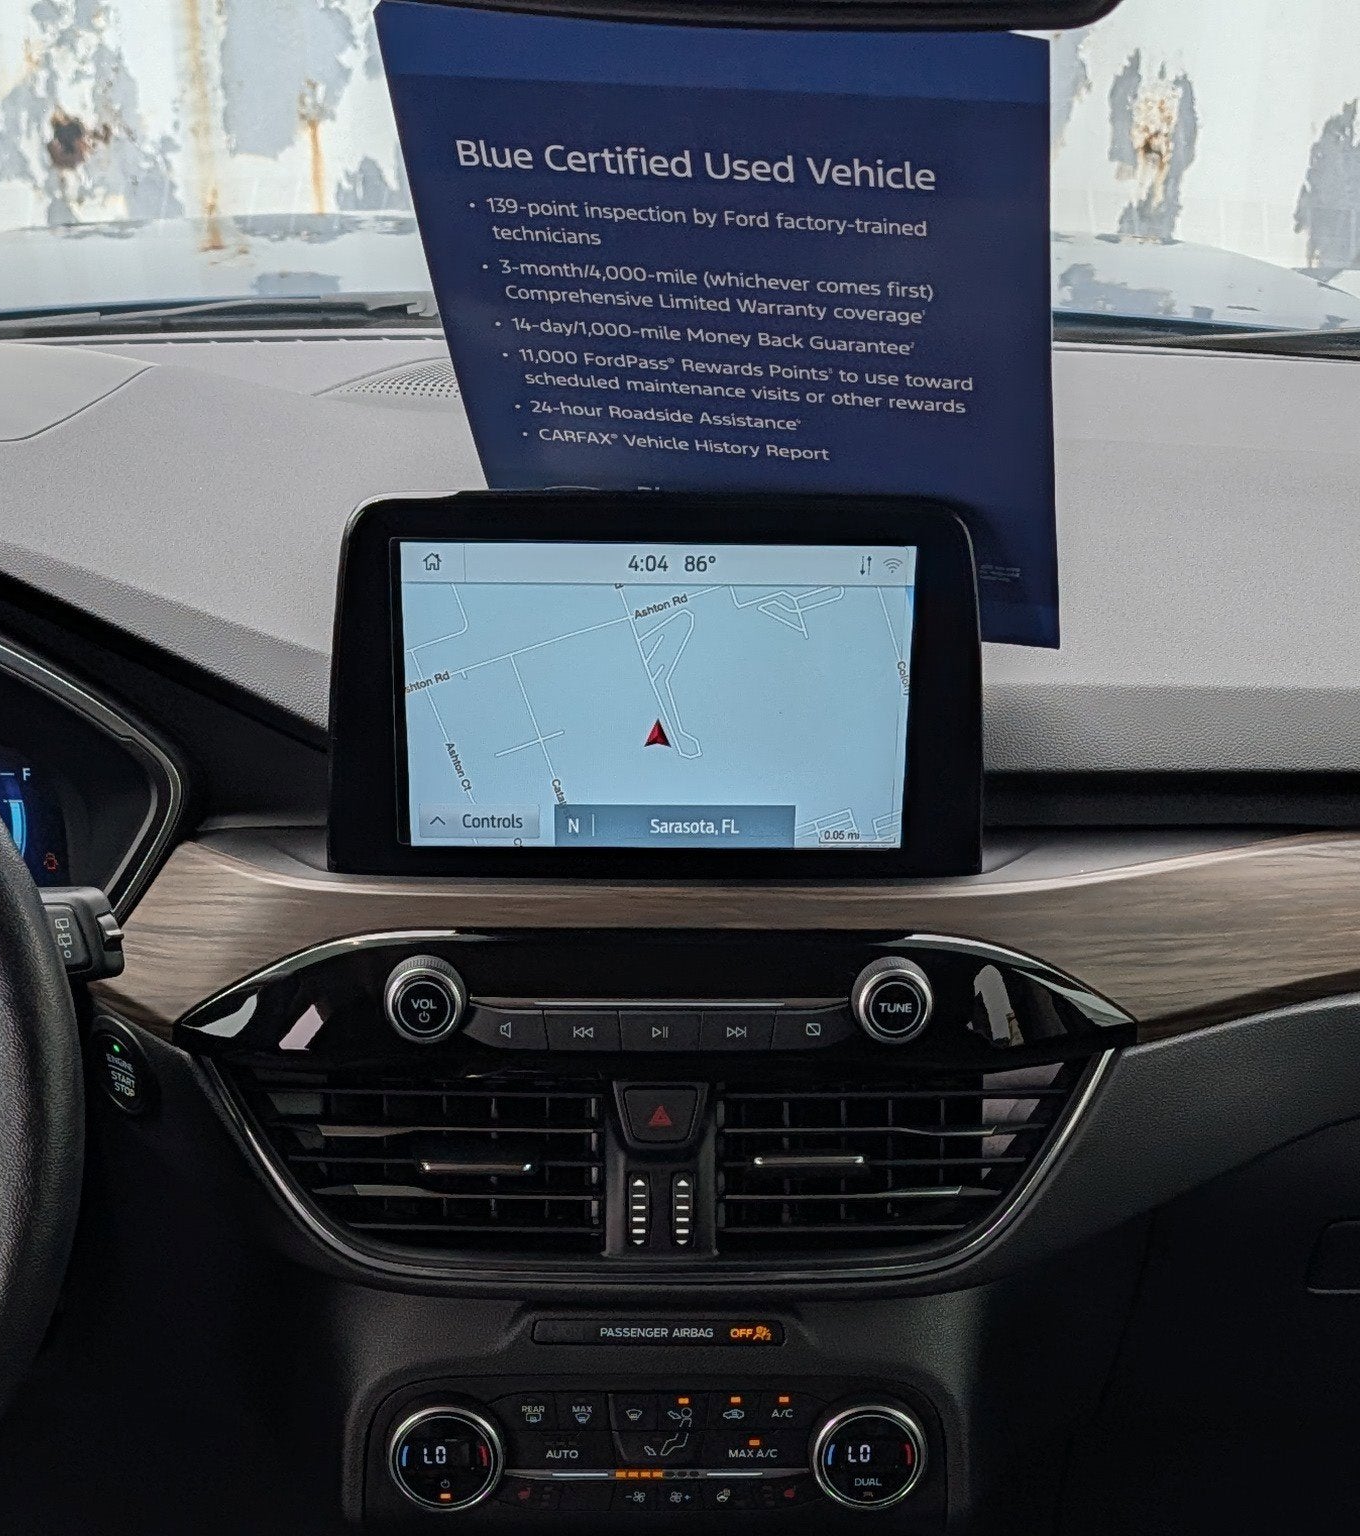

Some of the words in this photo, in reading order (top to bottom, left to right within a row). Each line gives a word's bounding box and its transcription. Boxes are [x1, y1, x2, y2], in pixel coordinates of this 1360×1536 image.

[455, 139, 534, 170] Blue
[544, 144, 693, 178] Certified
[704, 152, 795, 183] Used
[806, 157, 936, 191] Vehicle
[486, 198, 580, 218] 139-point
[584, 201, 687, 224] inspection
[692, 208, 717, 228] by
[724, 210, 769, 228] Ford
[776, 212, 927, 237] factory-trained
[492, 225, 602, 245] technicians
[498, 259, 697, 286] 3-month/4,000-mile
[703, 270, 810, 292] (whichever
[816, 279, 881, 296] comes
[887, 281, 934, 302] first)
[505, 285, 654, 308] Comprehensive
[659, 293, 731, 313] Limited
[737, 298, 827, 320] Warranty
[511, 317, 681, 341] 14-day/1,000-mile
[687, 327, 751, 348] Money
[758, 332, 803, 349] Back
[518, 348, 578, 364] 11,000
[681, 358, 764, 377] Rewards
[839, 369, 859, 383] to
[865, 371, 899, 386] use
[905, 373, 973, 391] toward
[525, 372, 620, 390] scheduled
[626, 379, 746, 399] maintenance
[751, 386, 800, 402] visits
[805, 391, 826, 403] or
[831, 392, 883, 408] other
[889, 397, 966, 414] rewards
[529, 400, 603, 418] 24-hour
[608, 405, 693, 424] Roadside
[622, 434, 690, 451] Vehicle
[695, 439, 760, 458] History
[765, 444, 831, 461] Report
[627, 555, 669, 572] 4:04
[684, 555, 717, 572] 86°
[634, 599, 671, 620] Ashton
[672, 594, 688, 607] Rd
[403, 678, 434, 693] shton
[434, 670, 450, 683] Rd
[21, 768, 32, 781] F
[445, 742, 466, 778] Ashton
[461, 778, 473, 792] Ct
[462, 813, 524, 829] Controls
[568, 818, 580, 834] N
[650, 819, 719, 836] Sarasota,
[721, 819, 740, 834] FL
[823, 830, 845, 841] 0.05
[847, 830, 860, 840] mi
[411, 999, 437, 1011] VOL
[879, 1003, 913, 1015] TUNE
[110, 1070, 135, 1089] START
[114, 1081, 135, 1097] STOP
[599, 1327, 669, 1338] PASSENGER
[672, 1327, 714, 1338] AIRBAG
[730, 1327, 753, 1339] OFF
[521, 1405, 545, 1413] REAR
[572, 1405, 593, 1413] MAX
[771, 1408, 793, 1419] A/C
[545, 1449, 579, 1460] AUTO
[728, 1449, 754, 1458] MAX
[756, 1449, 778, 1458] A/C
[854, 1477, 883, 1487] DUAL
